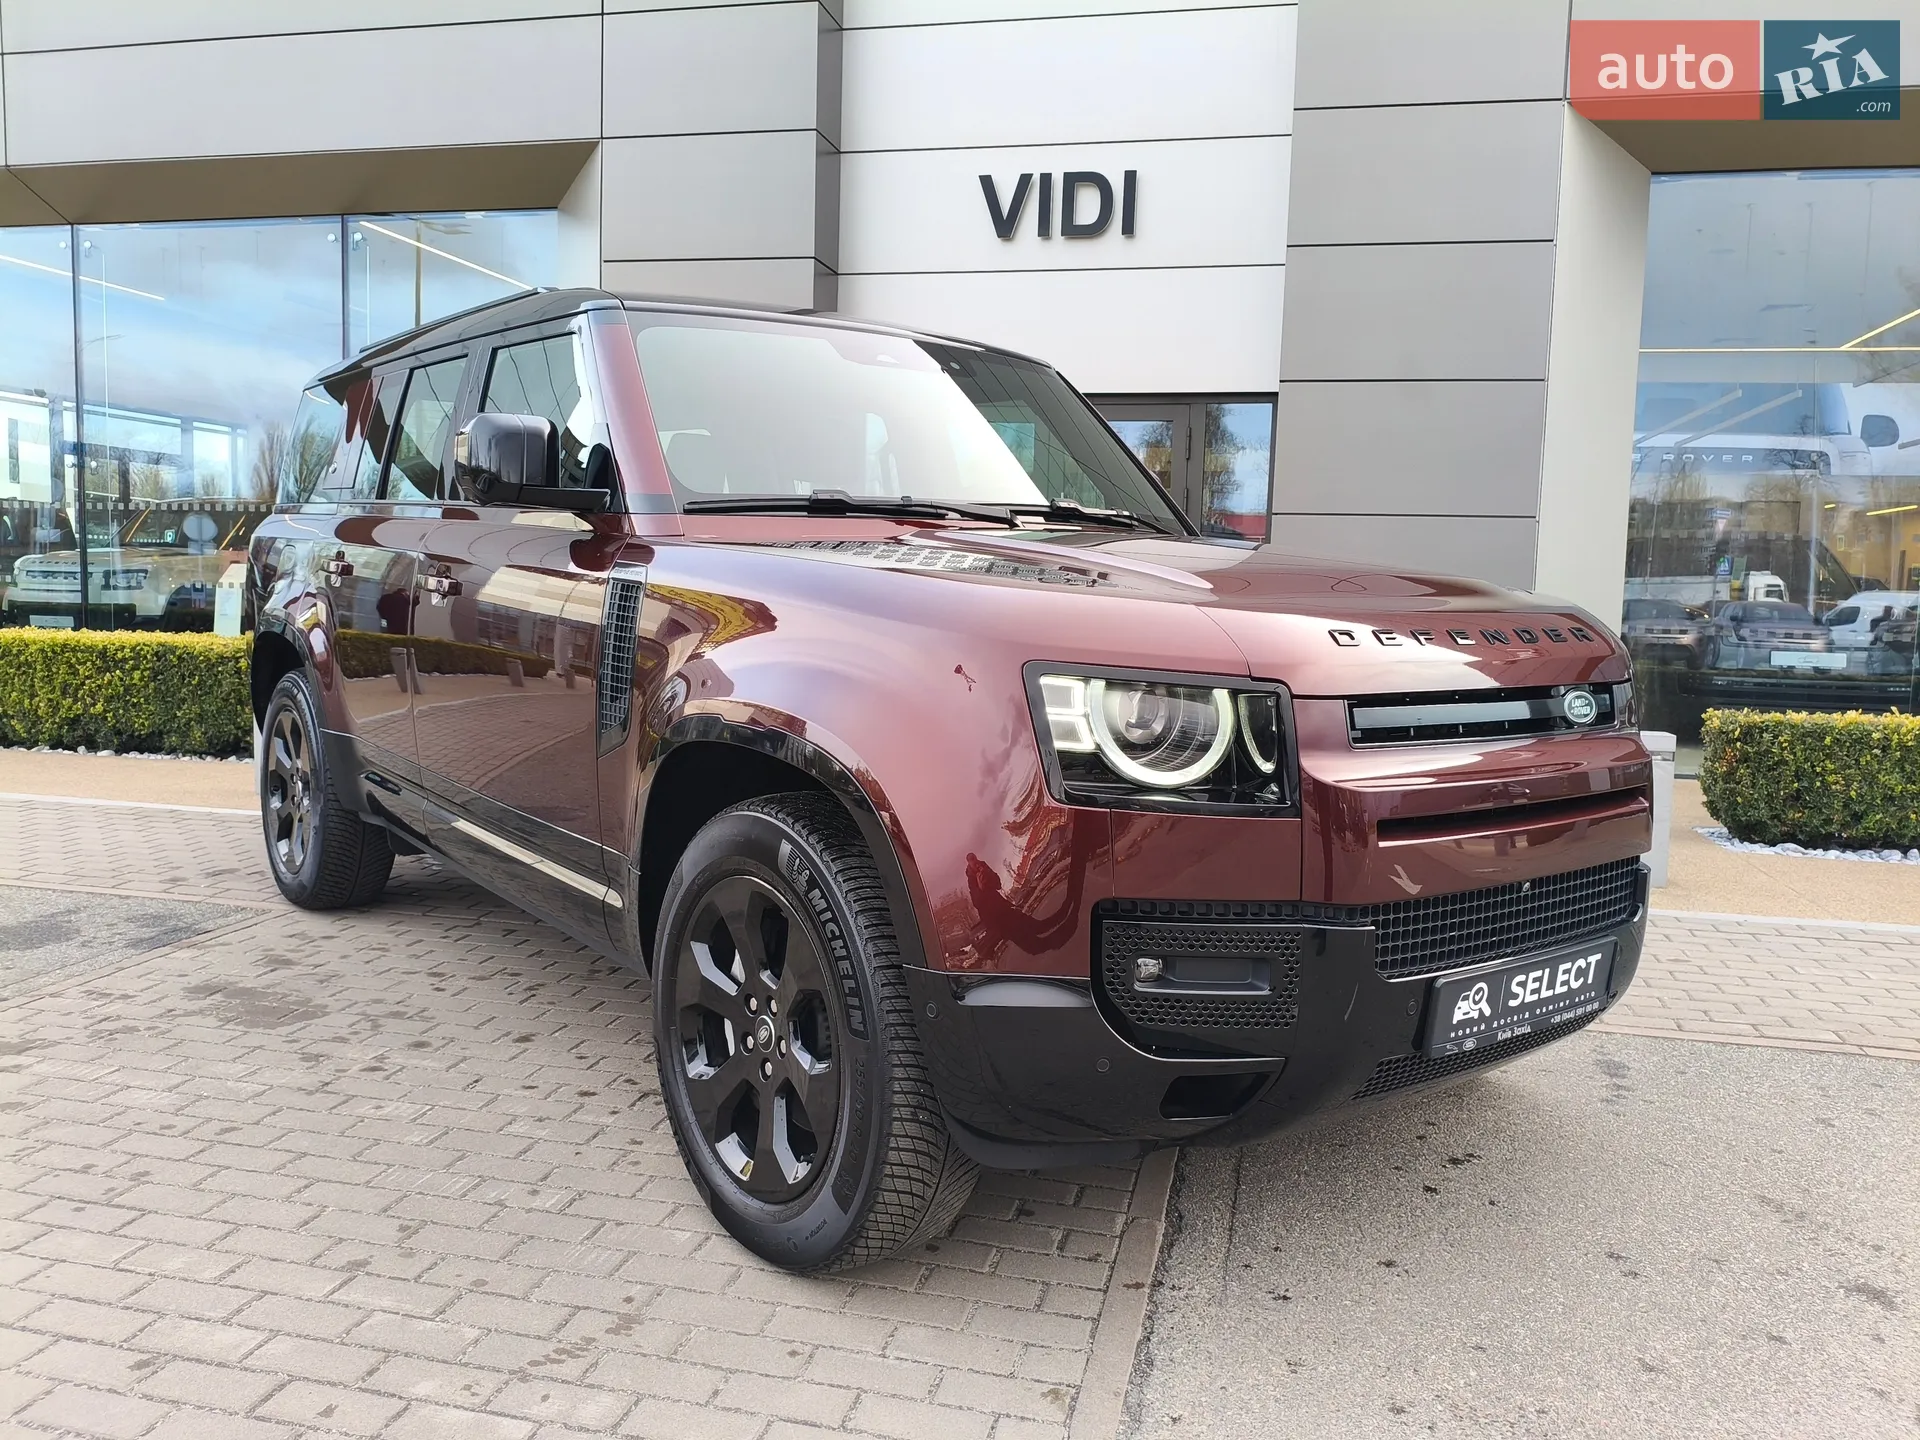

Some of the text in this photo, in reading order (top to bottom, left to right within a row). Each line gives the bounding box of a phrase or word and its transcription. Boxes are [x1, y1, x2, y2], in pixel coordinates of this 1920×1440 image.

[978, 169, 1138, 239] VIDI
[1327, 626, 1595, 647] DEFENDER
[1571, 698, 1586, 707] LAND
[1573, 706, 1591, 715] ROVER
[807, 888, 865, 1031] MICHELIN
[1508, 953, 1602, 1007] SELECT
[1450, 1022, 1485, 1038] НОВИЙ
[1492, 1011, 1530, 1028] ДОСВІД
[1575, 990, 1596, 1002] АВТО
